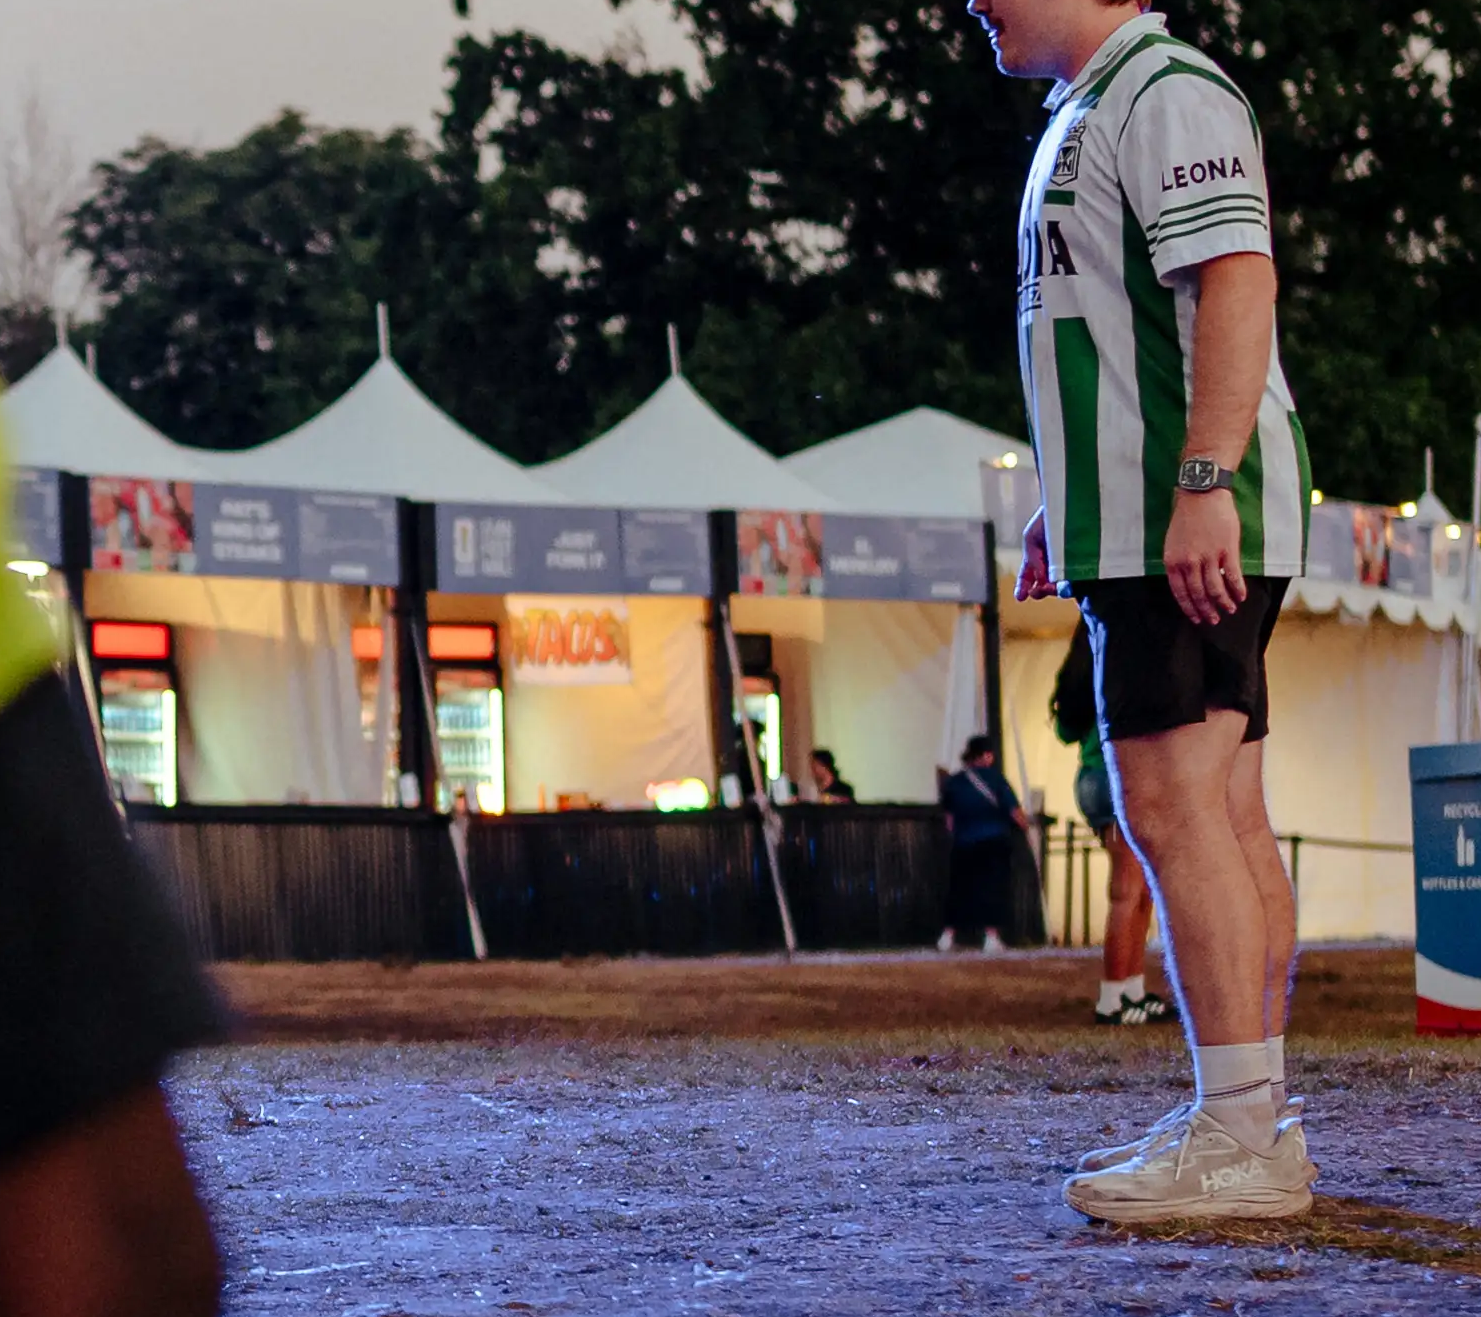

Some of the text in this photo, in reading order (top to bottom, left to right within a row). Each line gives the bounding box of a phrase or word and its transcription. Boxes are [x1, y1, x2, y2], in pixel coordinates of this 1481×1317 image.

[1161, 156, 1247, 193] LEONA
[525, 608, 618, 665] TACOS
[1200, 1159, 1264, 1193] HOKA
